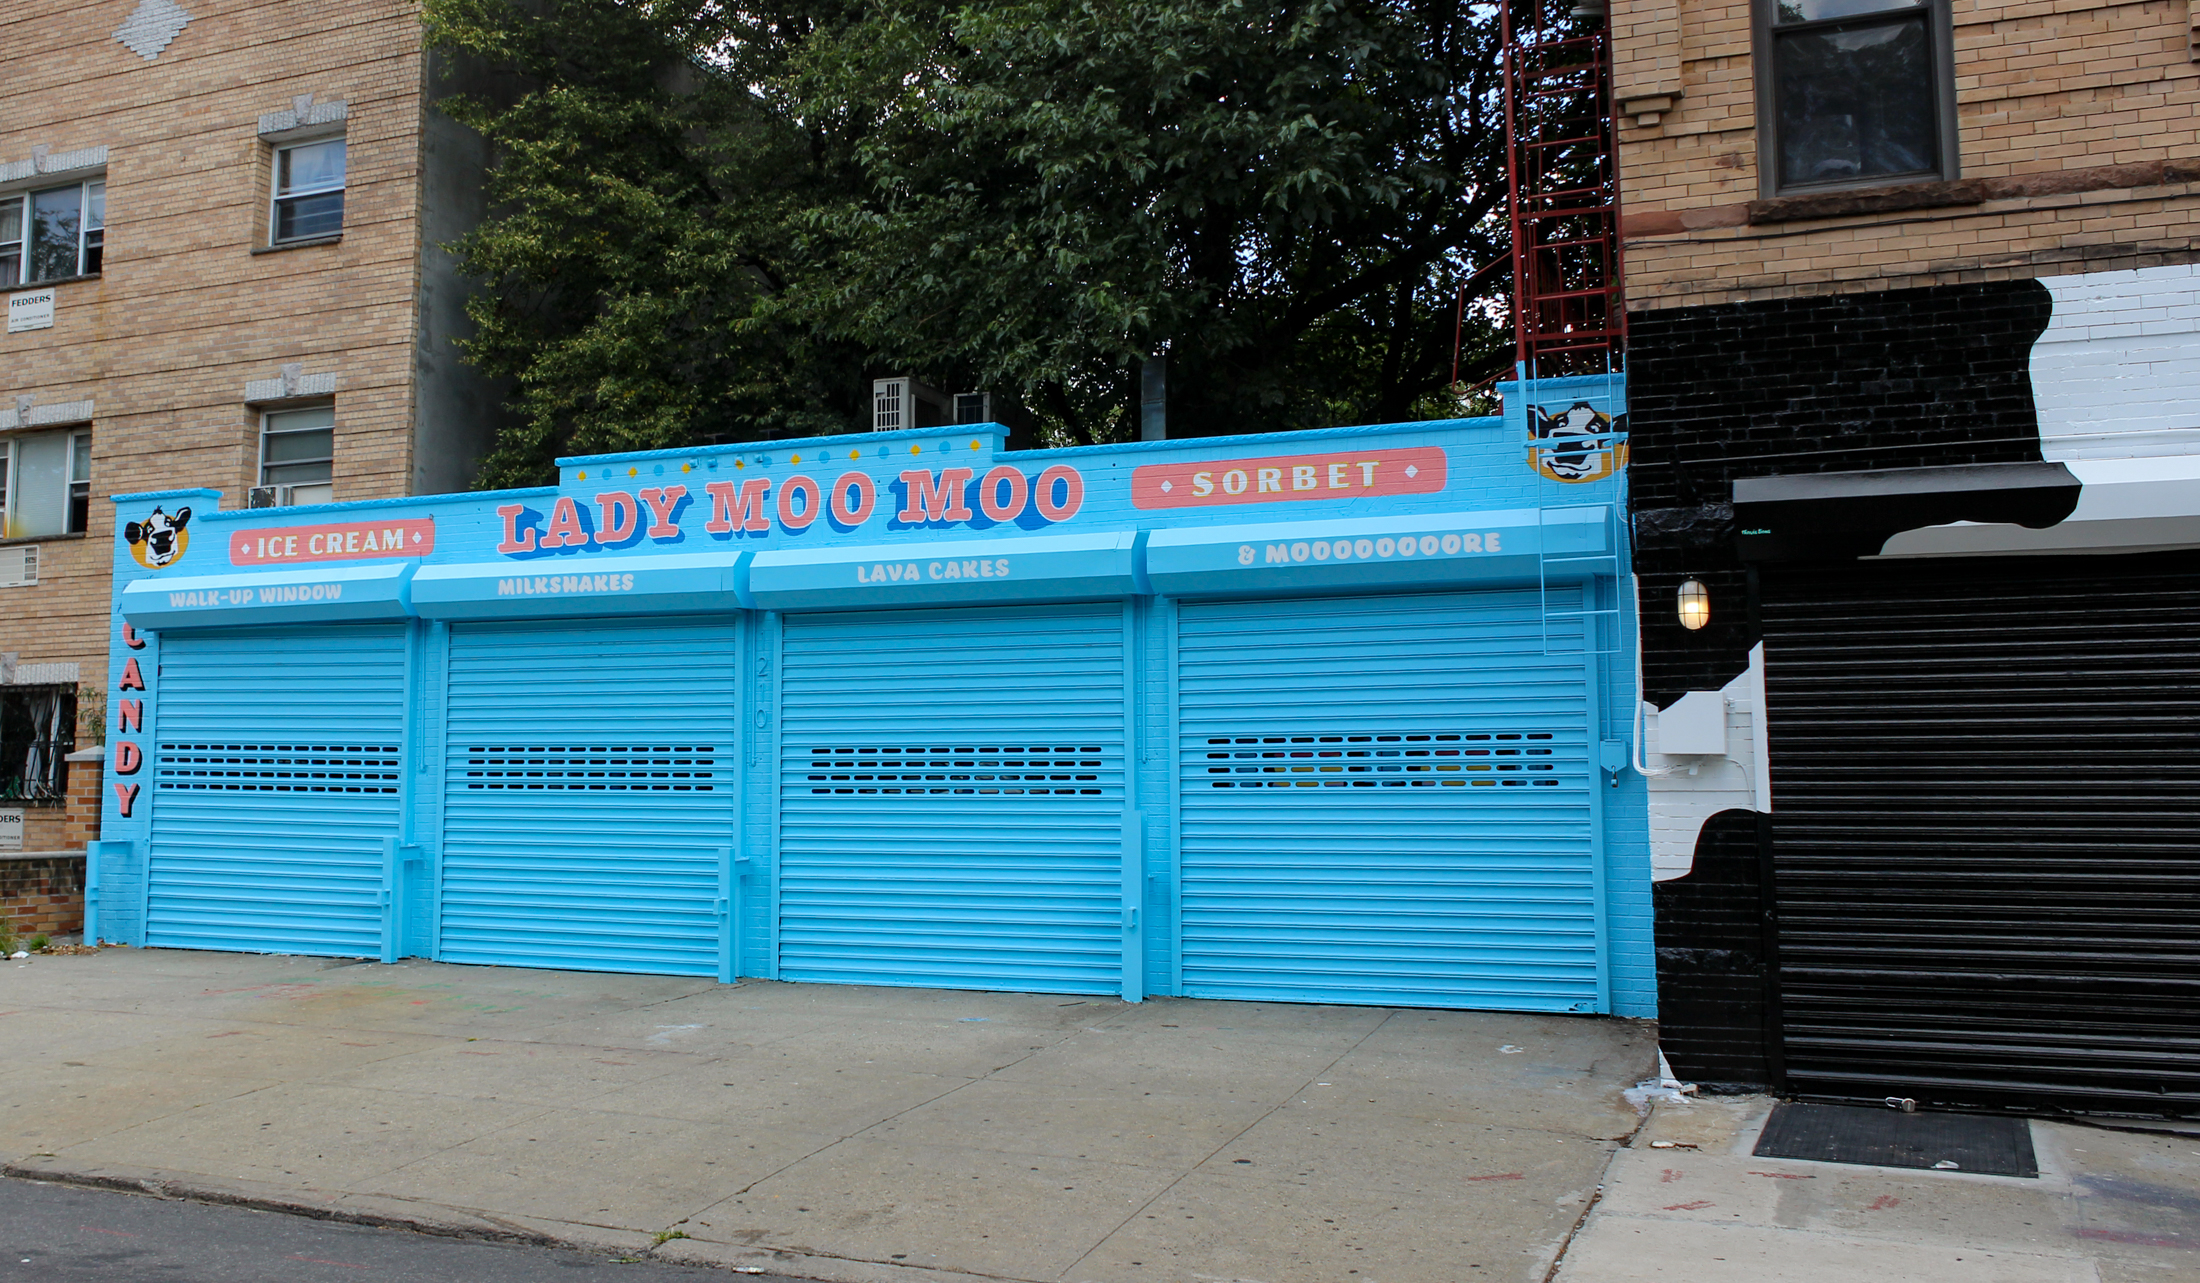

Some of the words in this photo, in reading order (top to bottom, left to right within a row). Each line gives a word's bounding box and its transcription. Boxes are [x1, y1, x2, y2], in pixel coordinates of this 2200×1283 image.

[11, 294, 51, 308] FEDDERS
[1191, 459, 1381, 498] SORBET
[496, 484, 688, 555] LADY
[705, 471, 876, 535] MOO
[896, 464, 1084, 524] MOO
[256, 535, 298, 559] ICE
[308, 527, 405, 556] CREAM
[1237, 544, 1256, 566] &
[1265, 532, 1502, 564] MOOOOOOOORE
[498, 573, 635, 596] MILKSHAKES
[857, 562, 921, 583] LAVA
[928, 559, 1010, 580] CAKES
[169, 588, 254, 608] WALK-UP
[259, 584, 343, 603] WINDOW
